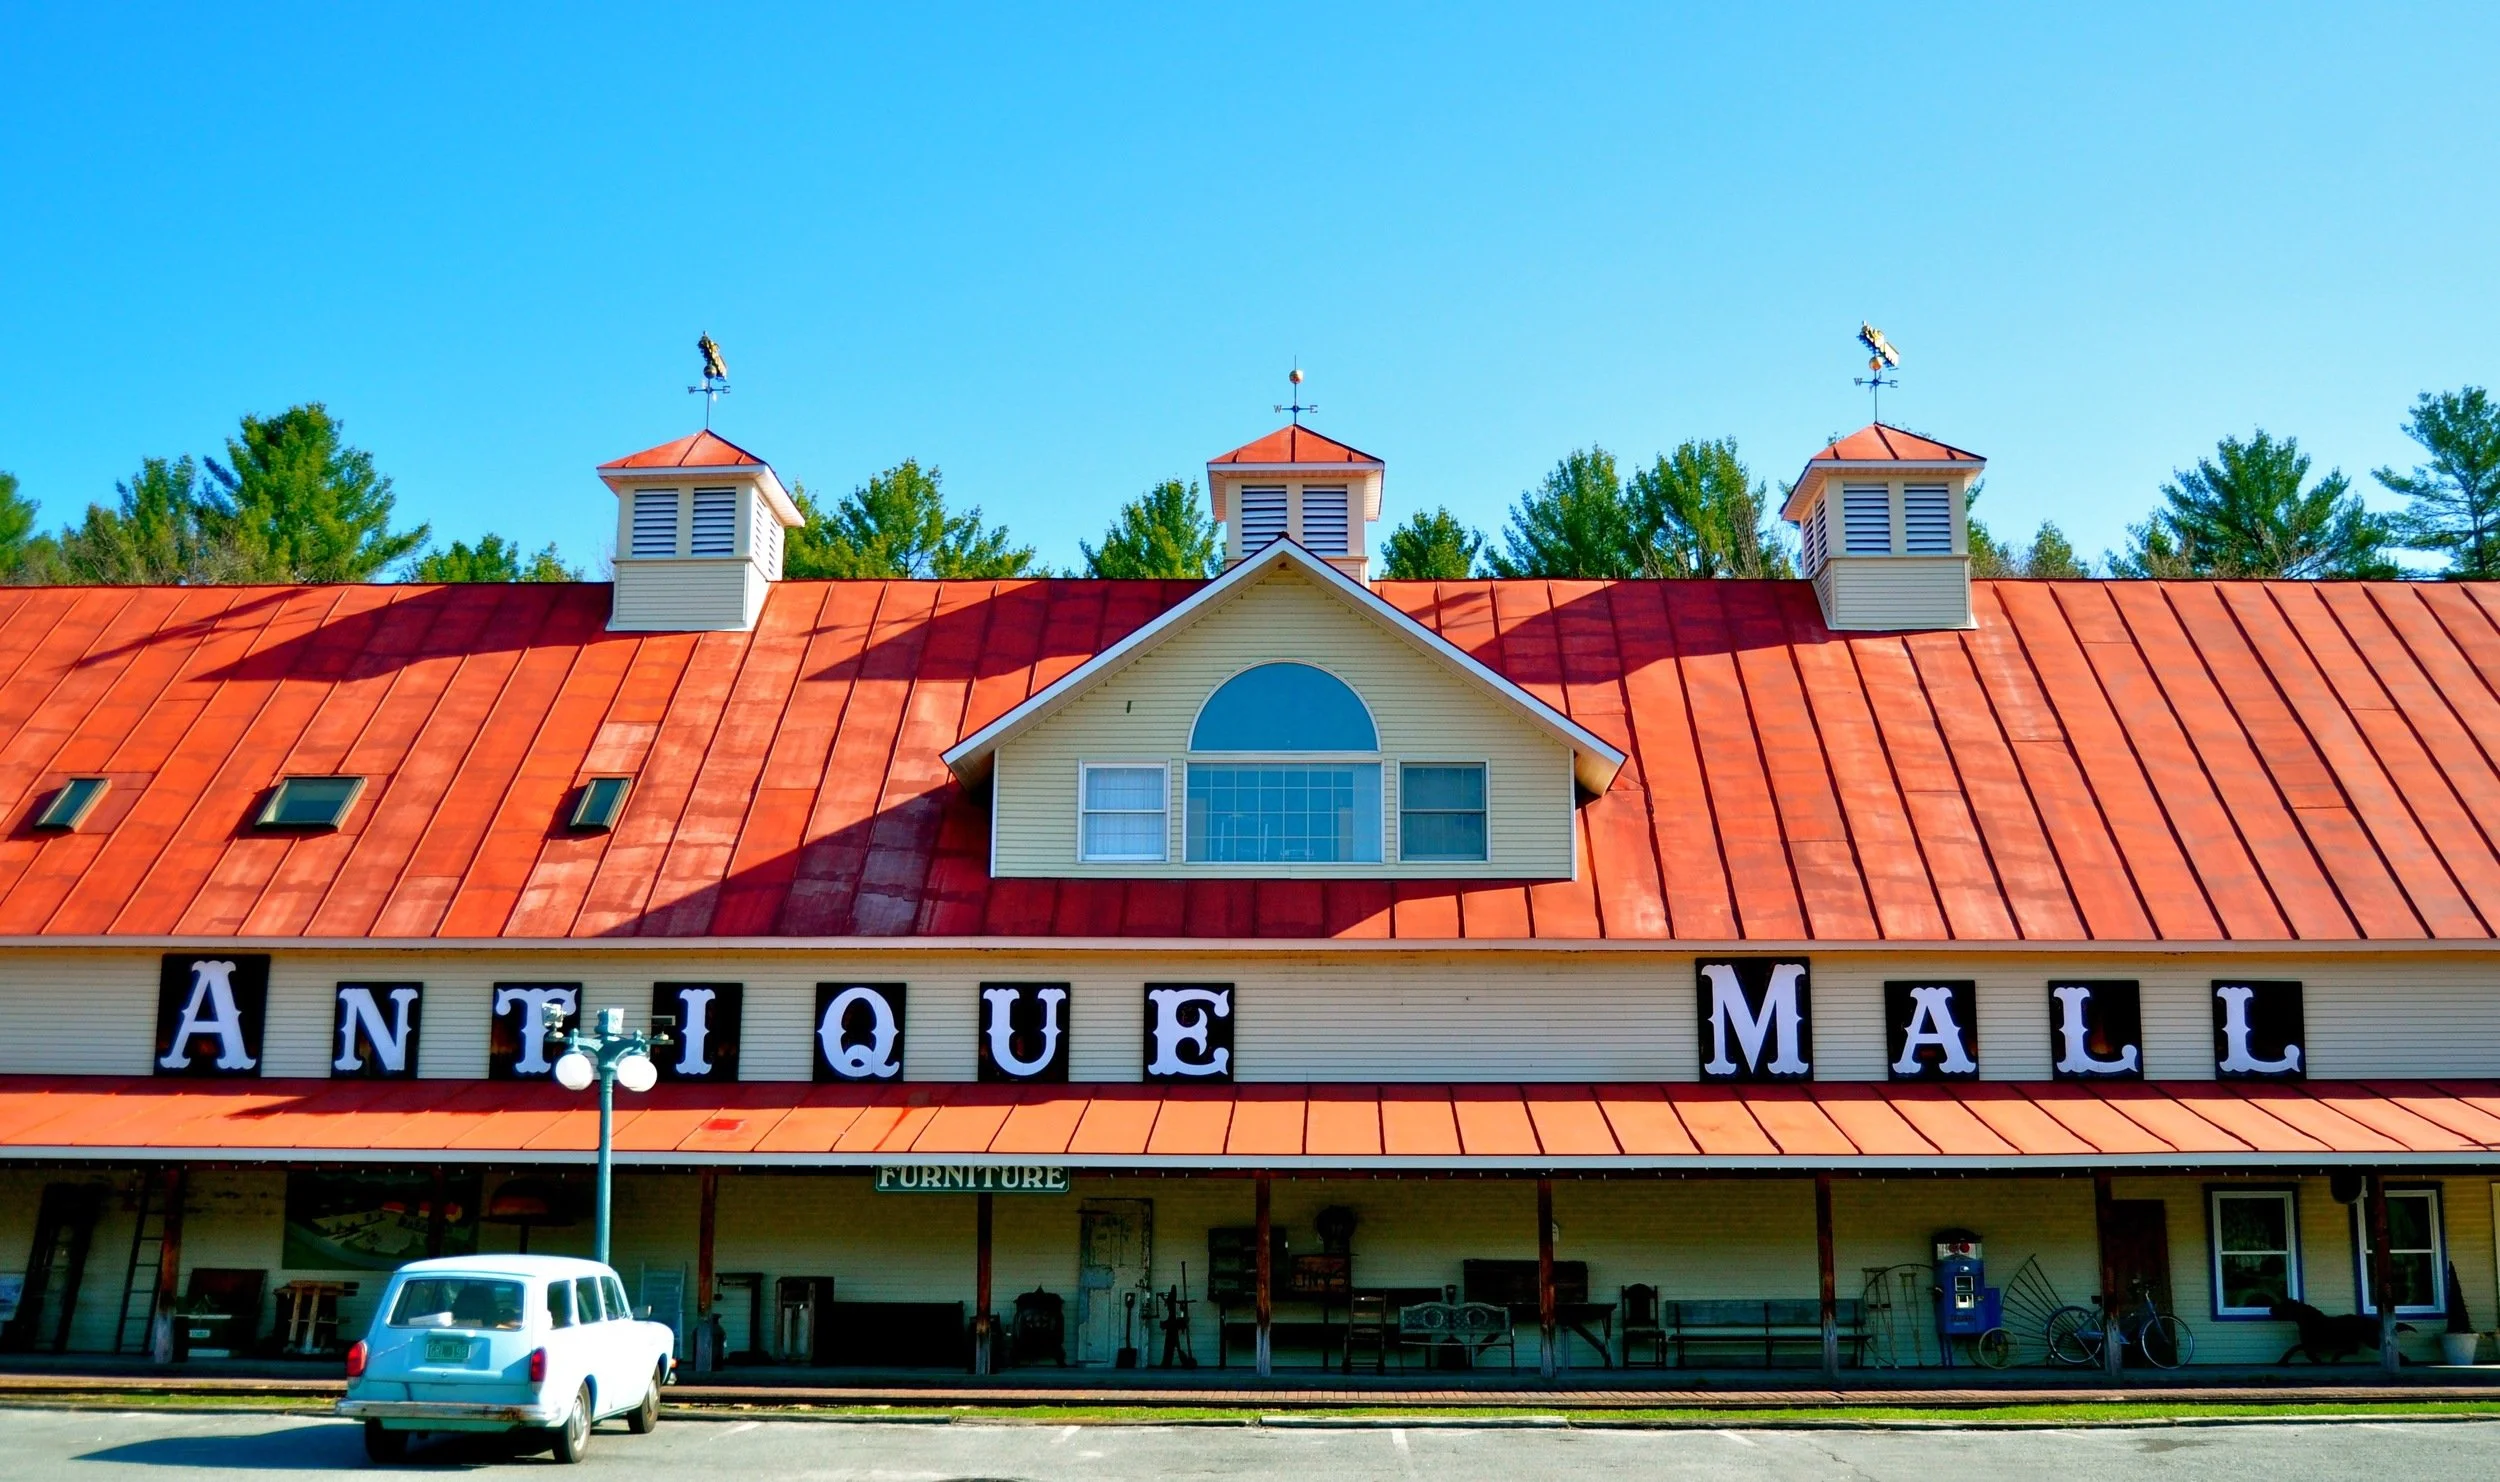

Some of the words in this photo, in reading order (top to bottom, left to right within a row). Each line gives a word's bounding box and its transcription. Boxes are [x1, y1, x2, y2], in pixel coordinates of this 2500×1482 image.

[1853, 378, 1862, 386] W
[1889, 379, 1898, 388] E
[687, 386, 696, 394] W
[722, 385, 731, 394] E
[1273, 404, 1282, 413] W
[1309, 404, 1318, 413] E
[160, 960, 1230, 1077] ANTIQUE
[1701, 963, 2301, 1076] MALL
[879, 1165, 1066, 1189] FURNITURE
